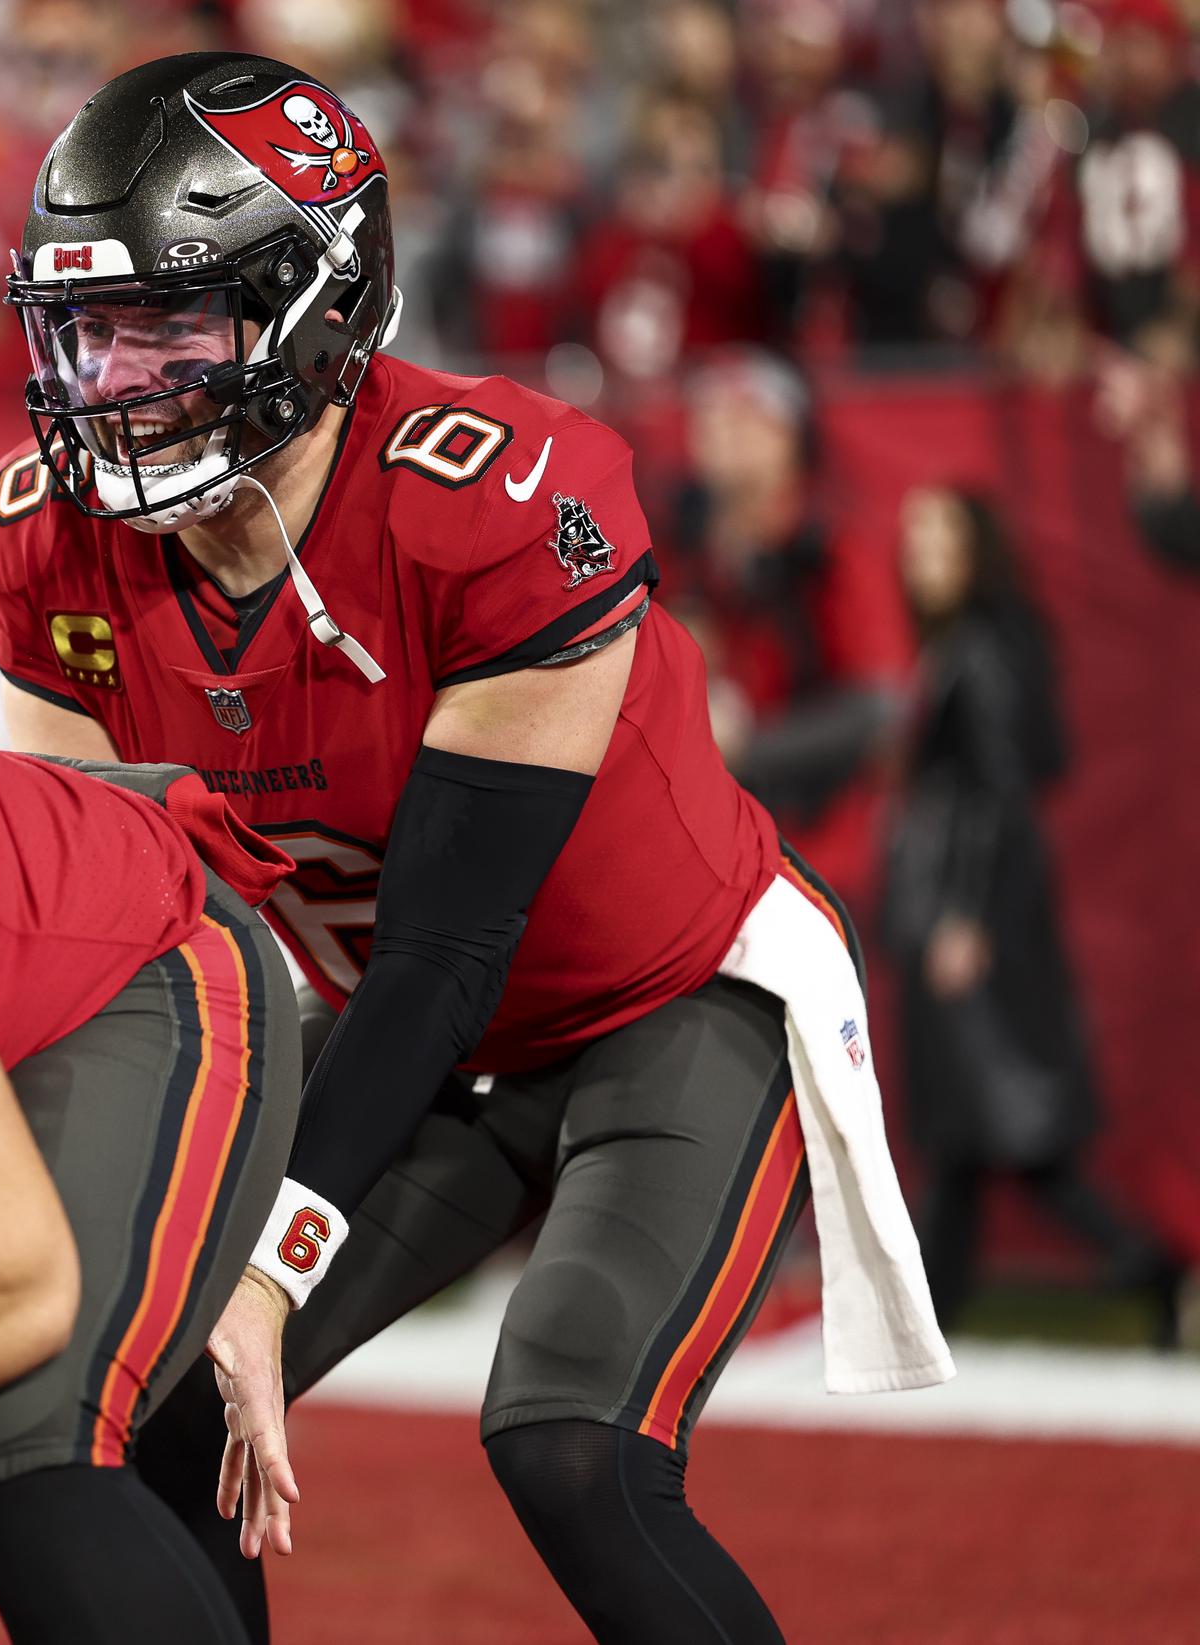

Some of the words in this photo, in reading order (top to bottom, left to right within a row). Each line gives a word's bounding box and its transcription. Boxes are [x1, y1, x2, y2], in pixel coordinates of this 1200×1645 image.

[53, 245, 93, 272] BUCS
[160, 253, 222, 270] OAKLEY
[377, 402, 515, 491] 6
[51, 614, 115, 672] C
[217, 708, 246, 726] NFL
[200, 758, 329, 799] UCCANEERS
[277, 1206, 331, 1274] 6
